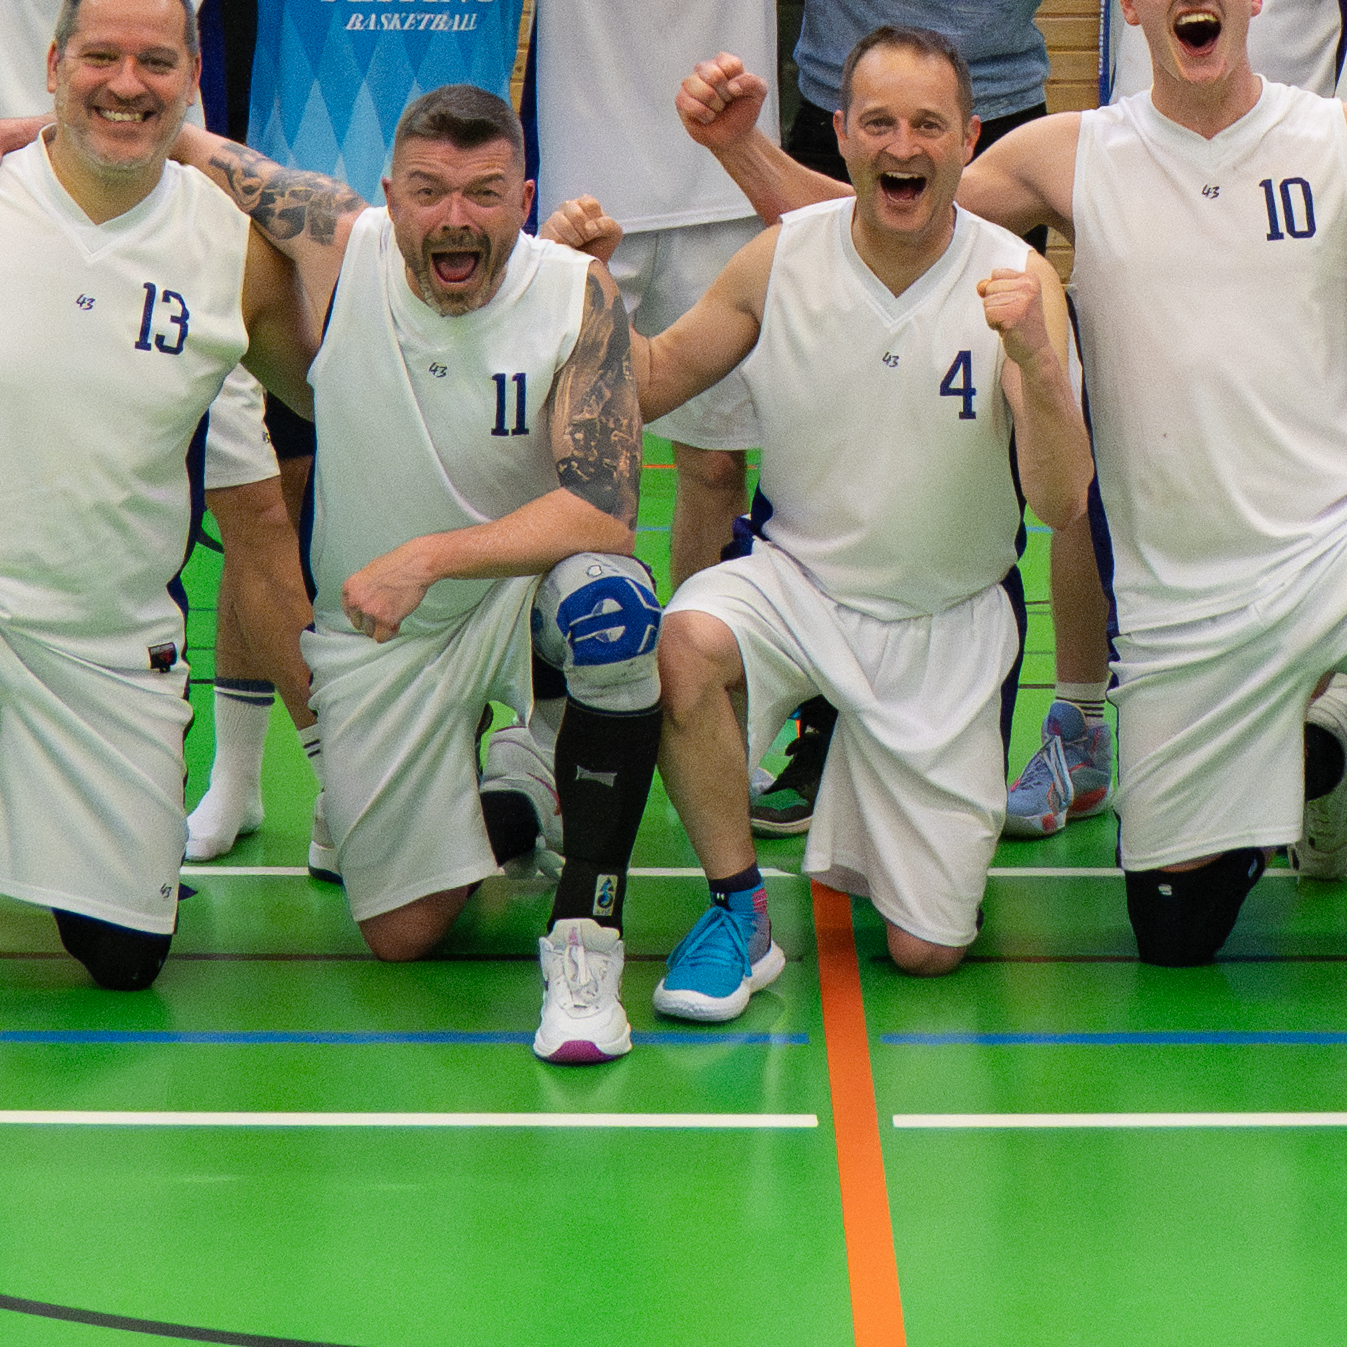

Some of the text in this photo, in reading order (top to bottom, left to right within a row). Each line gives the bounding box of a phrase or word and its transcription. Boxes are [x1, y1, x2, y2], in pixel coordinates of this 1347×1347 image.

[1258, 176, 1317, 242] 10
[134, 281, 191, 356] 13
[490, 372, 530, 437] 11
[939, 349, 978, 421] 4
